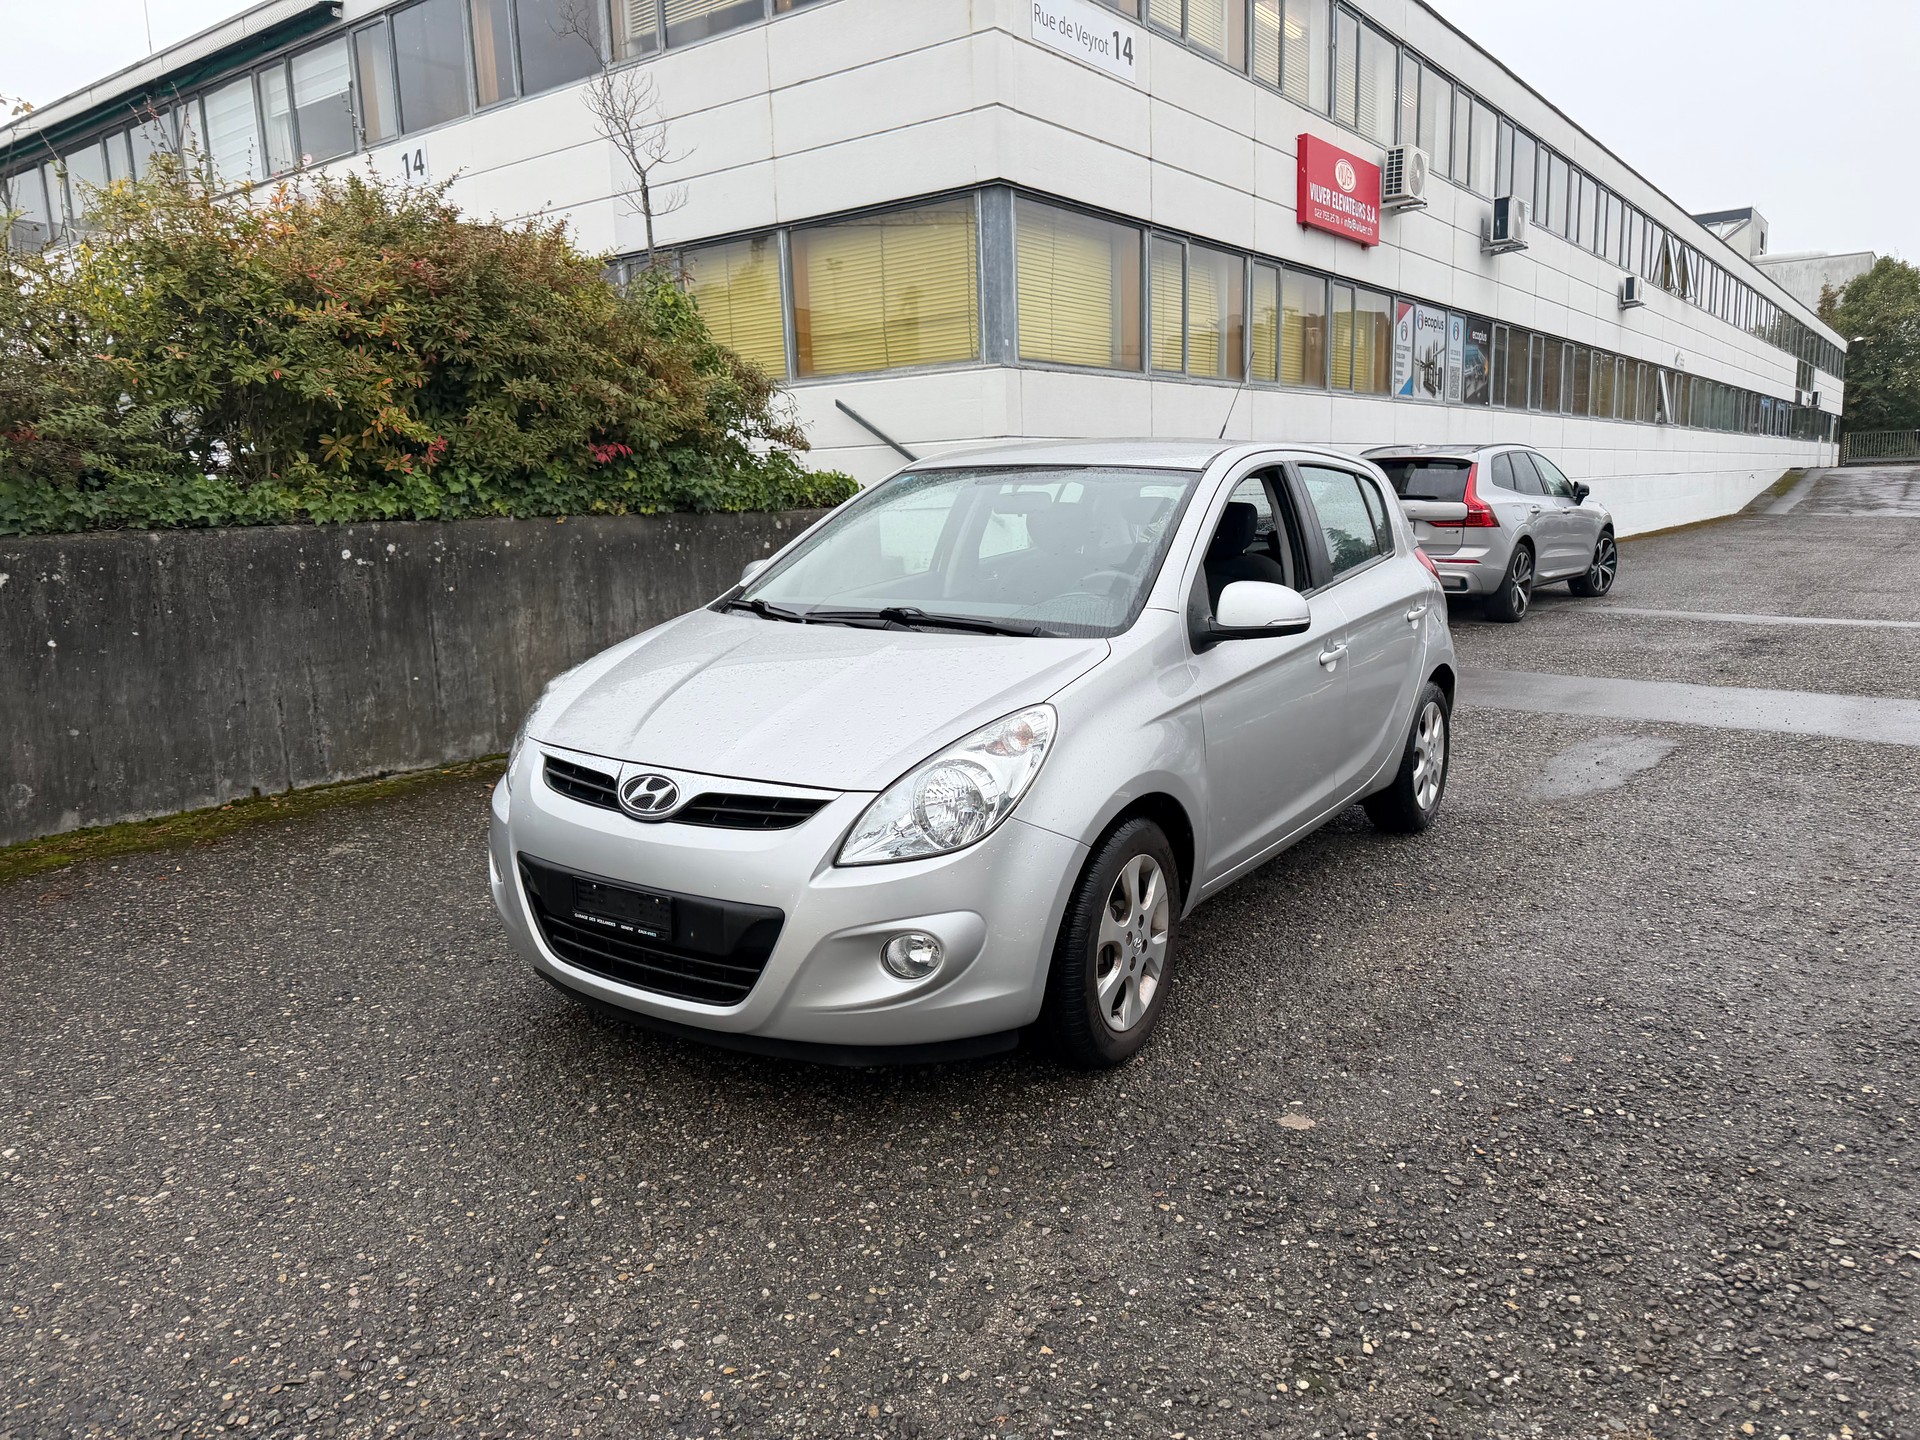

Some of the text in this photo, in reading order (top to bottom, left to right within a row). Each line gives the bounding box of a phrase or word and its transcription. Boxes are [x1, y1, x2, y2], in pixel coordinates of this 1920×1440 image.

[1033, 2, 1134, 66] Rue de Veyrot 14
[401, 148, 425, 180] 14
[1309, 181, 1377, 225] VILVER ELEVATEURS S.A.
[1424, 315, 1444, 332] ecoplus
[1472, 329, 1487, 343] ecoplus
[574, 912, 588, 920] GARAGE
